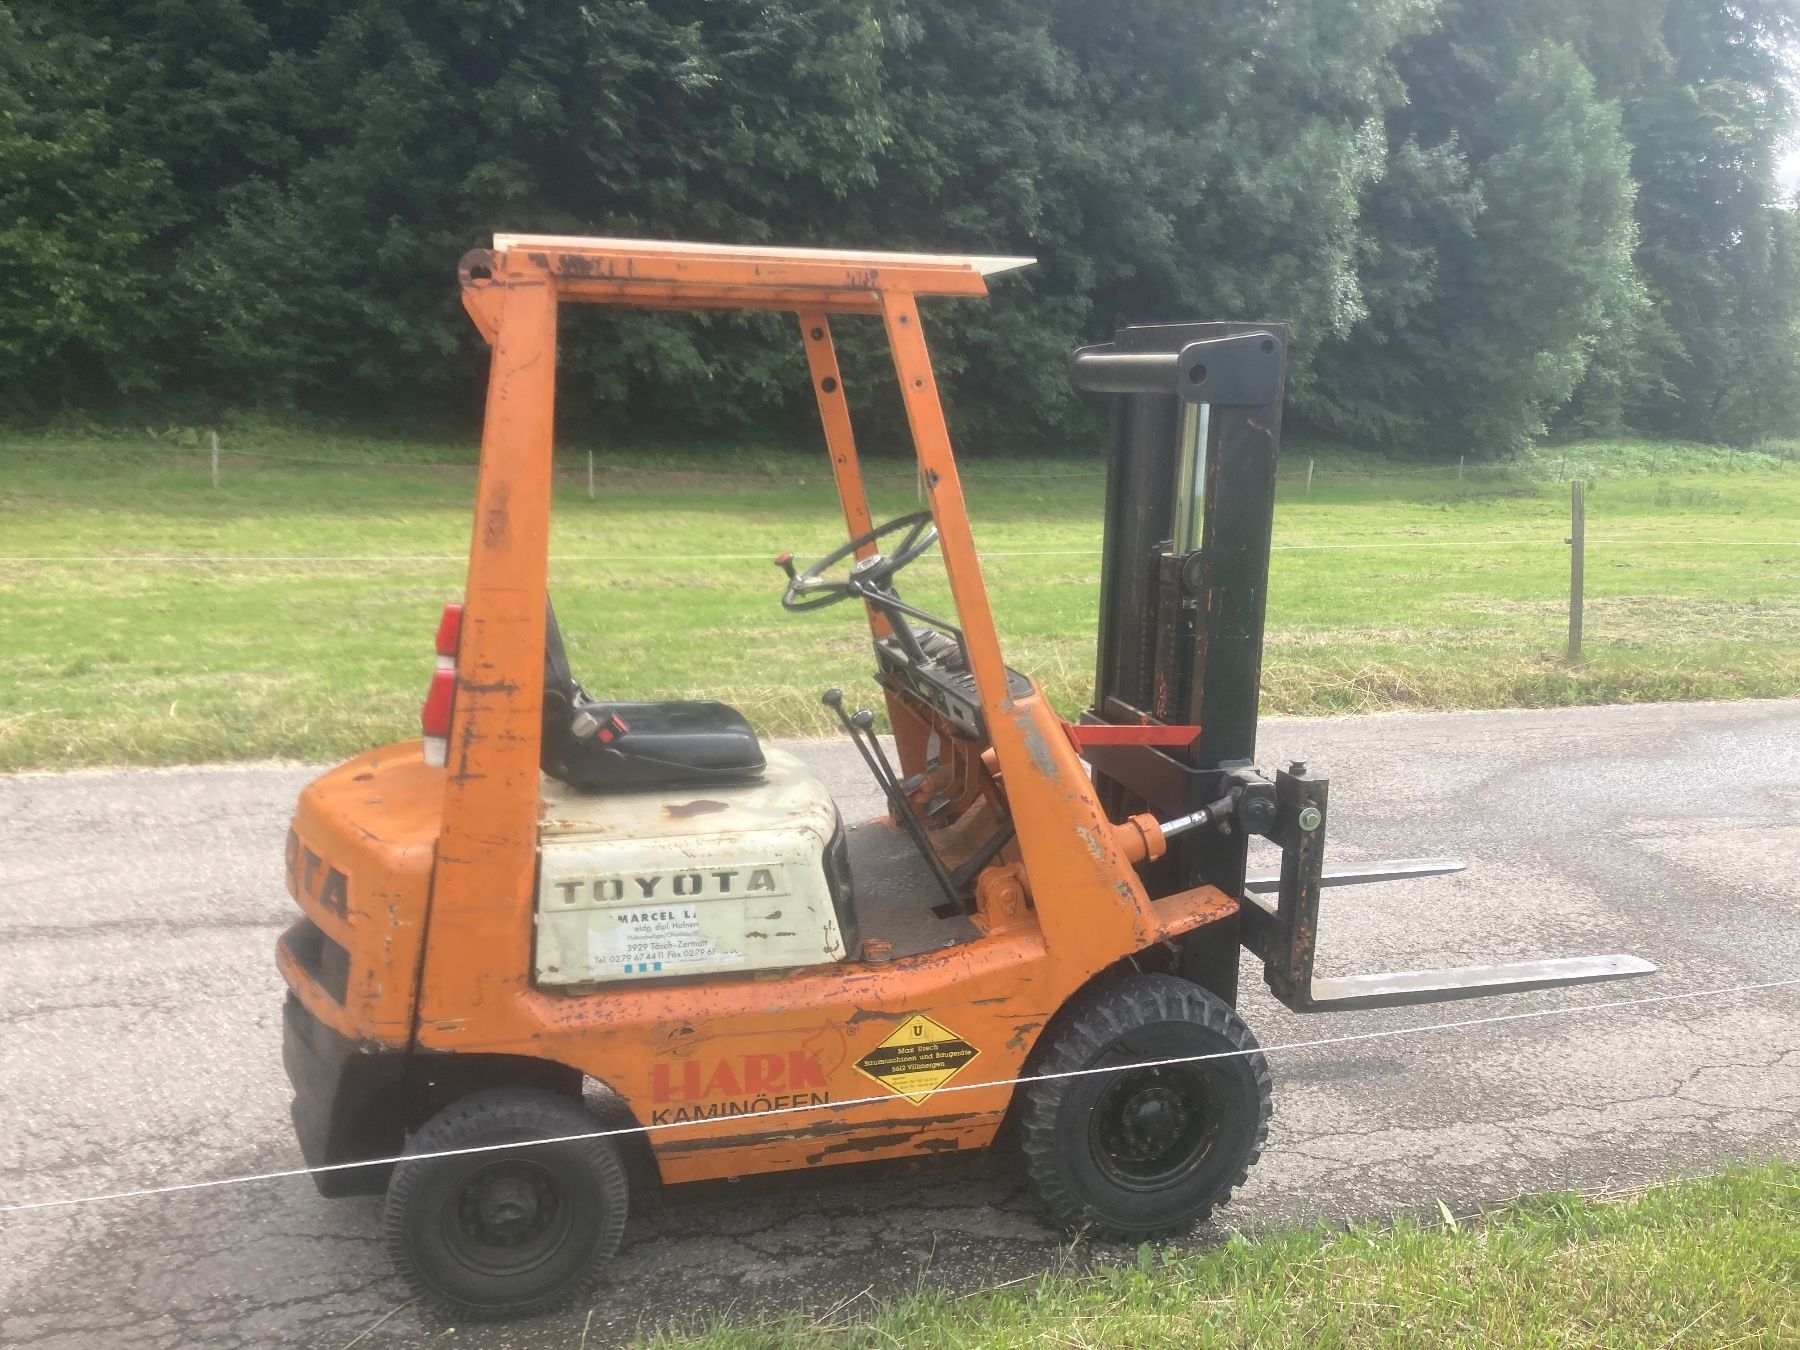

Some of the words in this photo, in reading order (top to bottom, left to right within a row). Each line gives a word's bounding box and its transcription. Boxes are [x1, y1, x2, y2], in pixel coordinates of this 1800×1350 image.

[555, 869, 776, 904] TOYOTA
[618, 911, 675, 923] MARCEL
[627, 943, 648, 952] 3929
[667, 951, 681, 959] Fax
[913, 1025, 923, 1037] U
[864, 1055, 917, 1067] Baumaschinen
[653, 1050, 828, 1105] HARK
[652, 1091, 829, 1127] KAMINÖFEN
